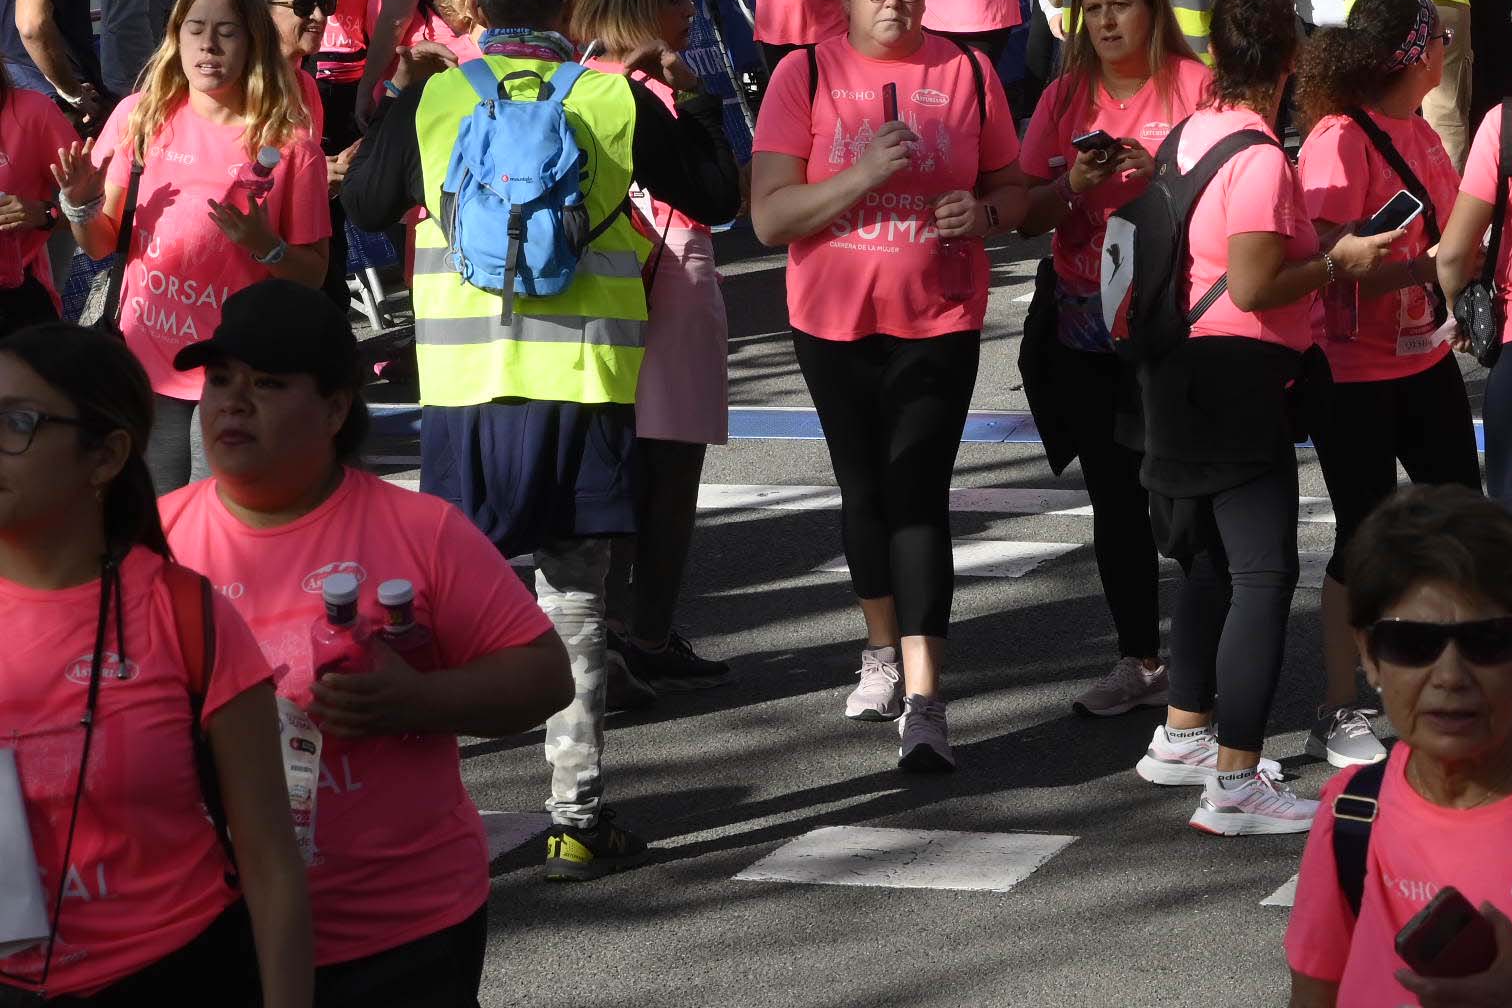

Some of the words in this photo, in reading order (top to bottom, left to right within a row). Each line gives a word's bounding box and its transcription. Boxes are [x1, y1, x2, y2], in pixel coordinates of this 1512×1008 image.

[832, 89, 875, 101] OYSHO
[867, 192, 925, 209] DORS
[832, 208, 939, 244] SUMA
[139, 229, 160, 258] TU
[830, 241, 857, 251] CARRERA
[858, 243, 867, 251] DE
[132, 296, 199, 340] SUMA
